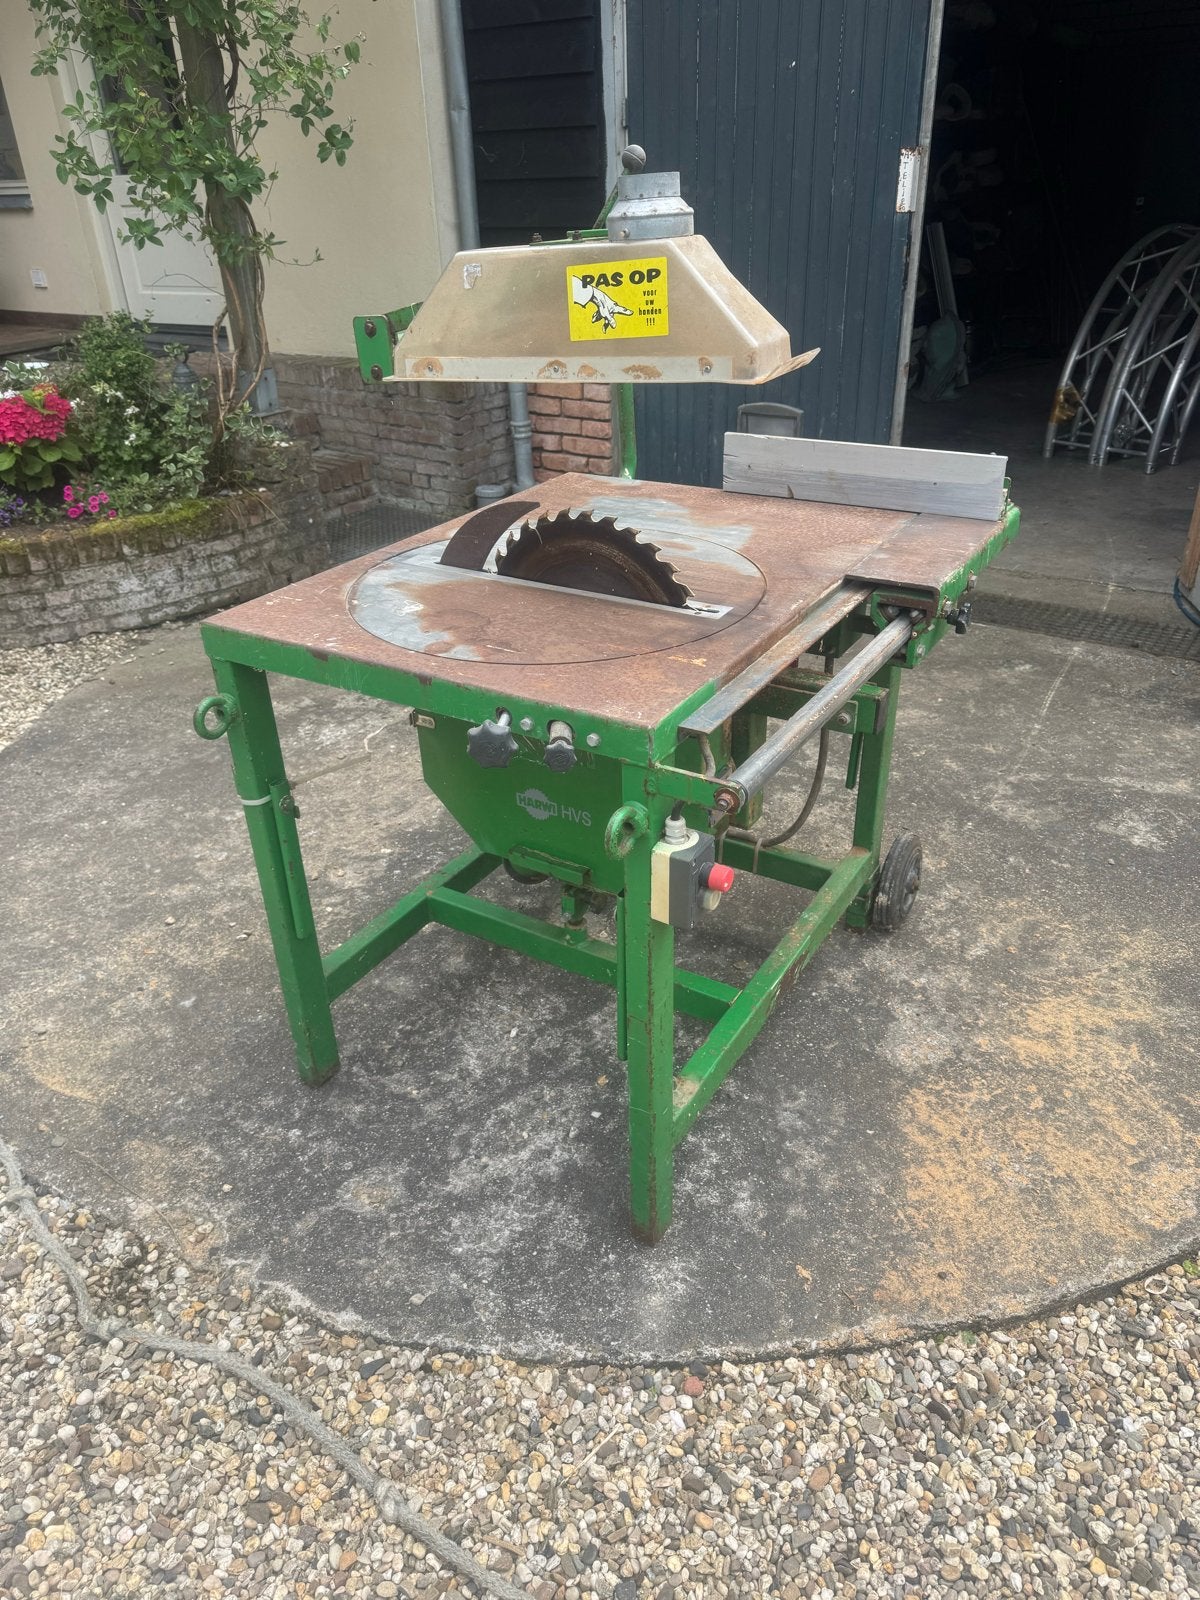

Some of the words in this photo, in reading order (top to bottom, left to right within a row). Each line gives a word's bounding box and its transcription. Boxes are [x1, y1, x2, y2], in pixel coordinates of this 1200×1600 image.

[582, 272, 623, 288] PAS
[629, 268, 661, 285] OP
[646, 318, 655, 326] !!!
[517, 794, 556, 815] HARWI
[561, 805, 592, 826] HVS
